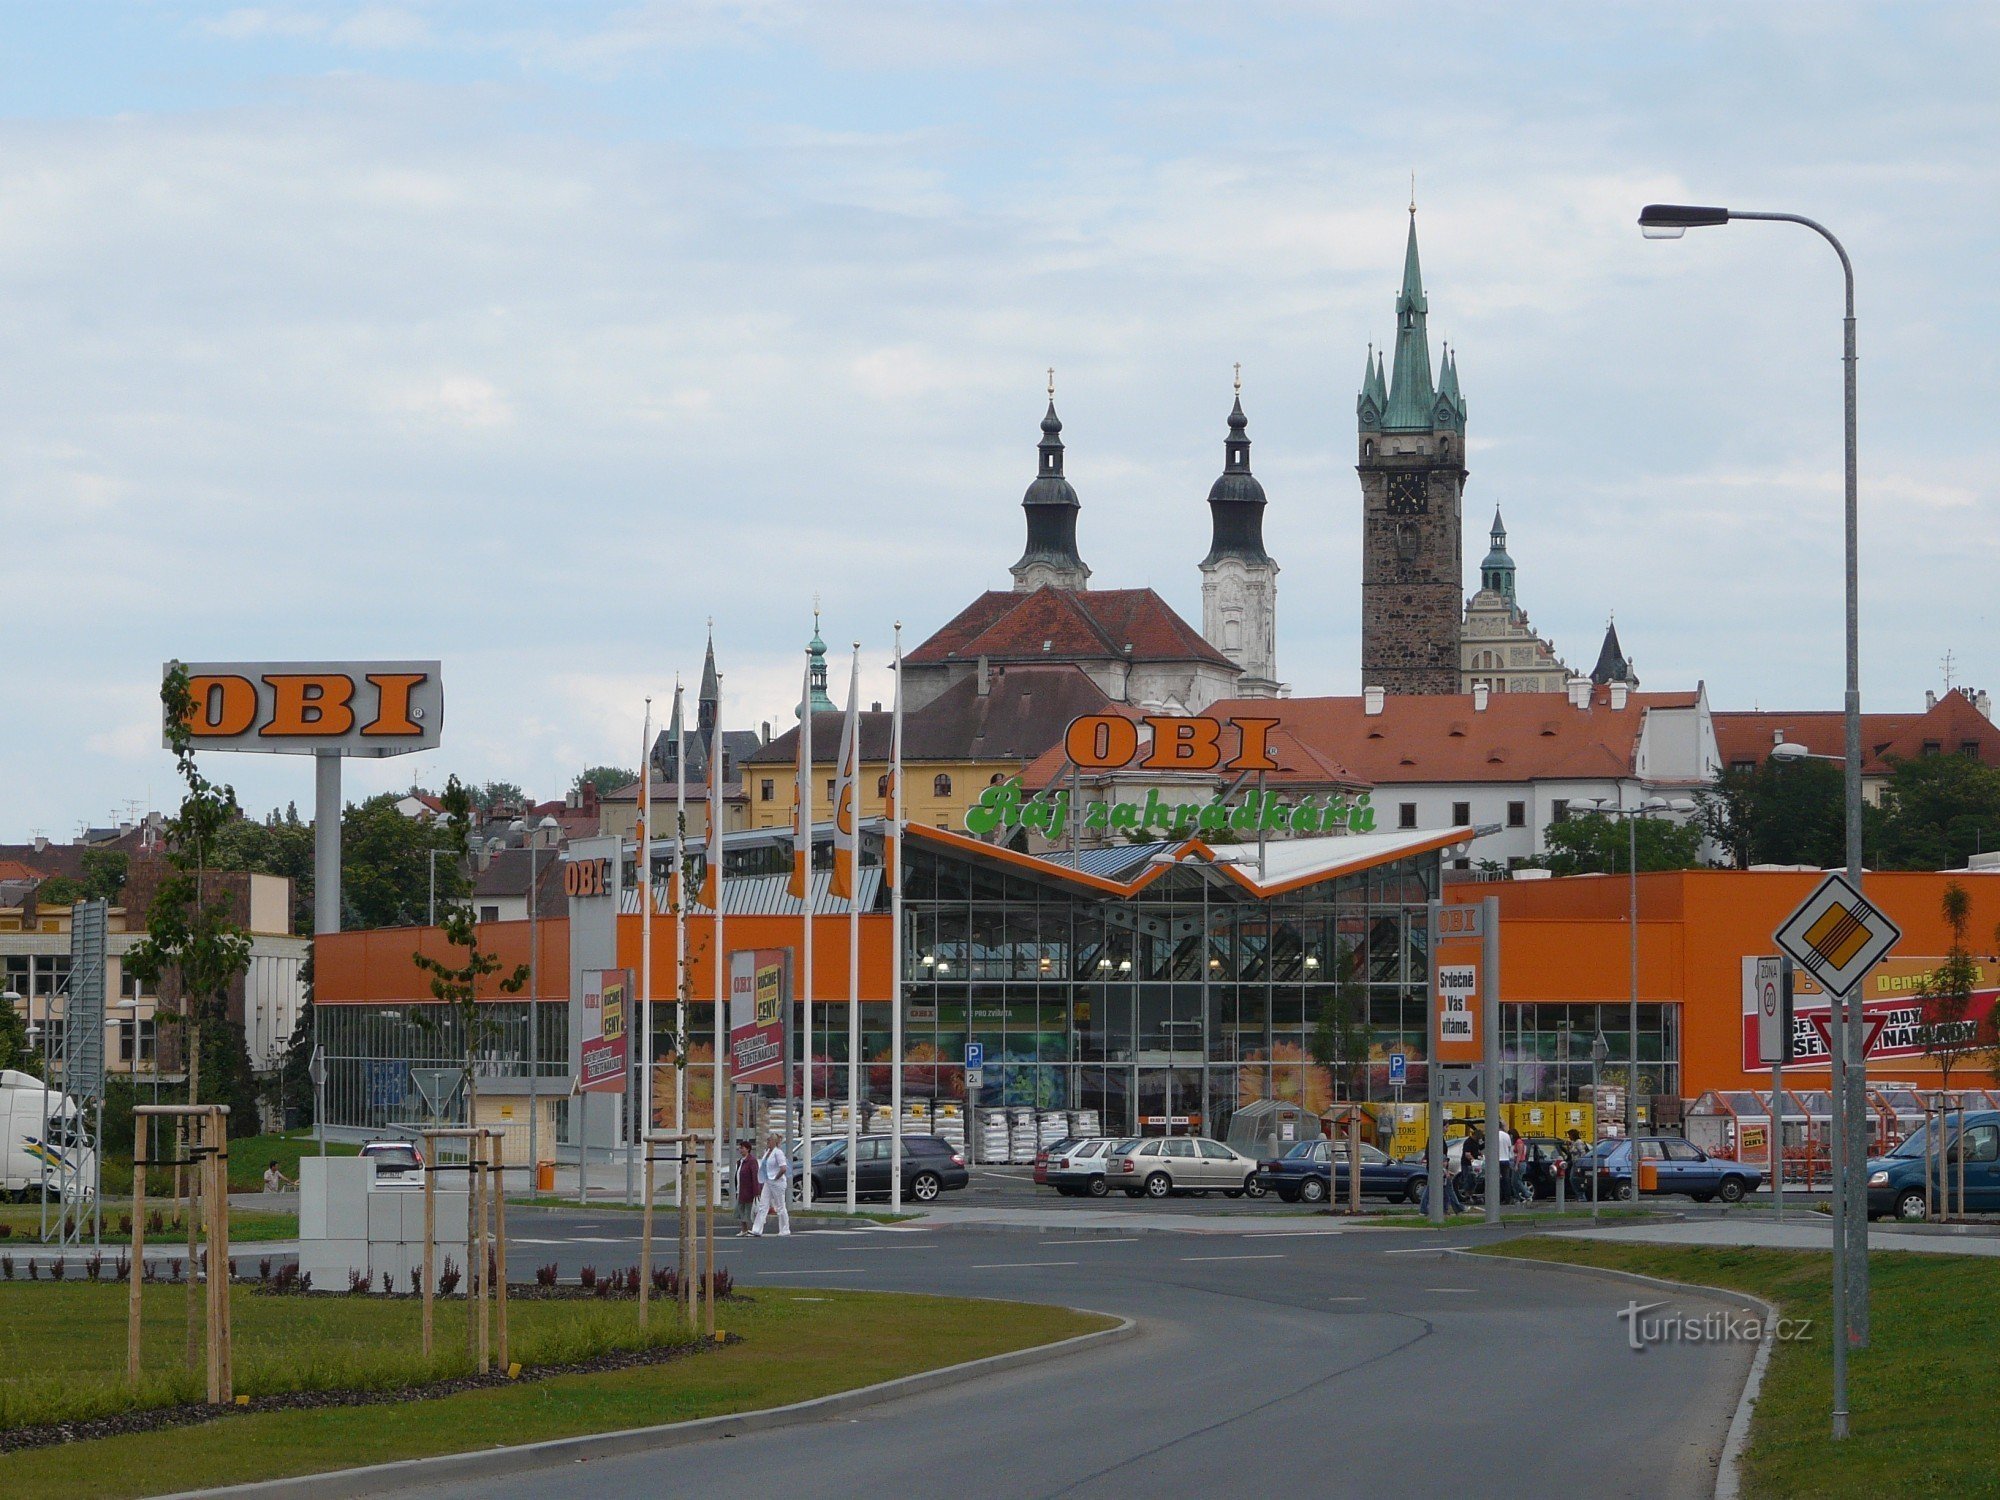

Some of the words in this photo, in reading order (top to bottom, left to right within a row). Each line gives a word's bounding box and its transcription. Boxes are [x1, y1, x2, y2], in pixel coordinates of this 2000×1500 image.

[182, 674, 427, 737] OBI
[1064, 714, 1280, 770] OBI
[964, 777, 1070, 839] Ráj
[1084, 788, 1377, 832] zahrádkářů
[564, 858, 606, 896] OBI
[1438, 910, 1475, 932] OBI
[1440, 971, 1474, 988] Srdečně
[1761, 963, 1778, 979] ZÓNA
[1447, 995, 1463, 1012] Vás
[1767, 993, 1775, 1008] 20
[1442, 1017, 1471, 1034] vítáme.
[968, 1046, 979, 1061] P
[1393, 1057, 1402, 1071] P
